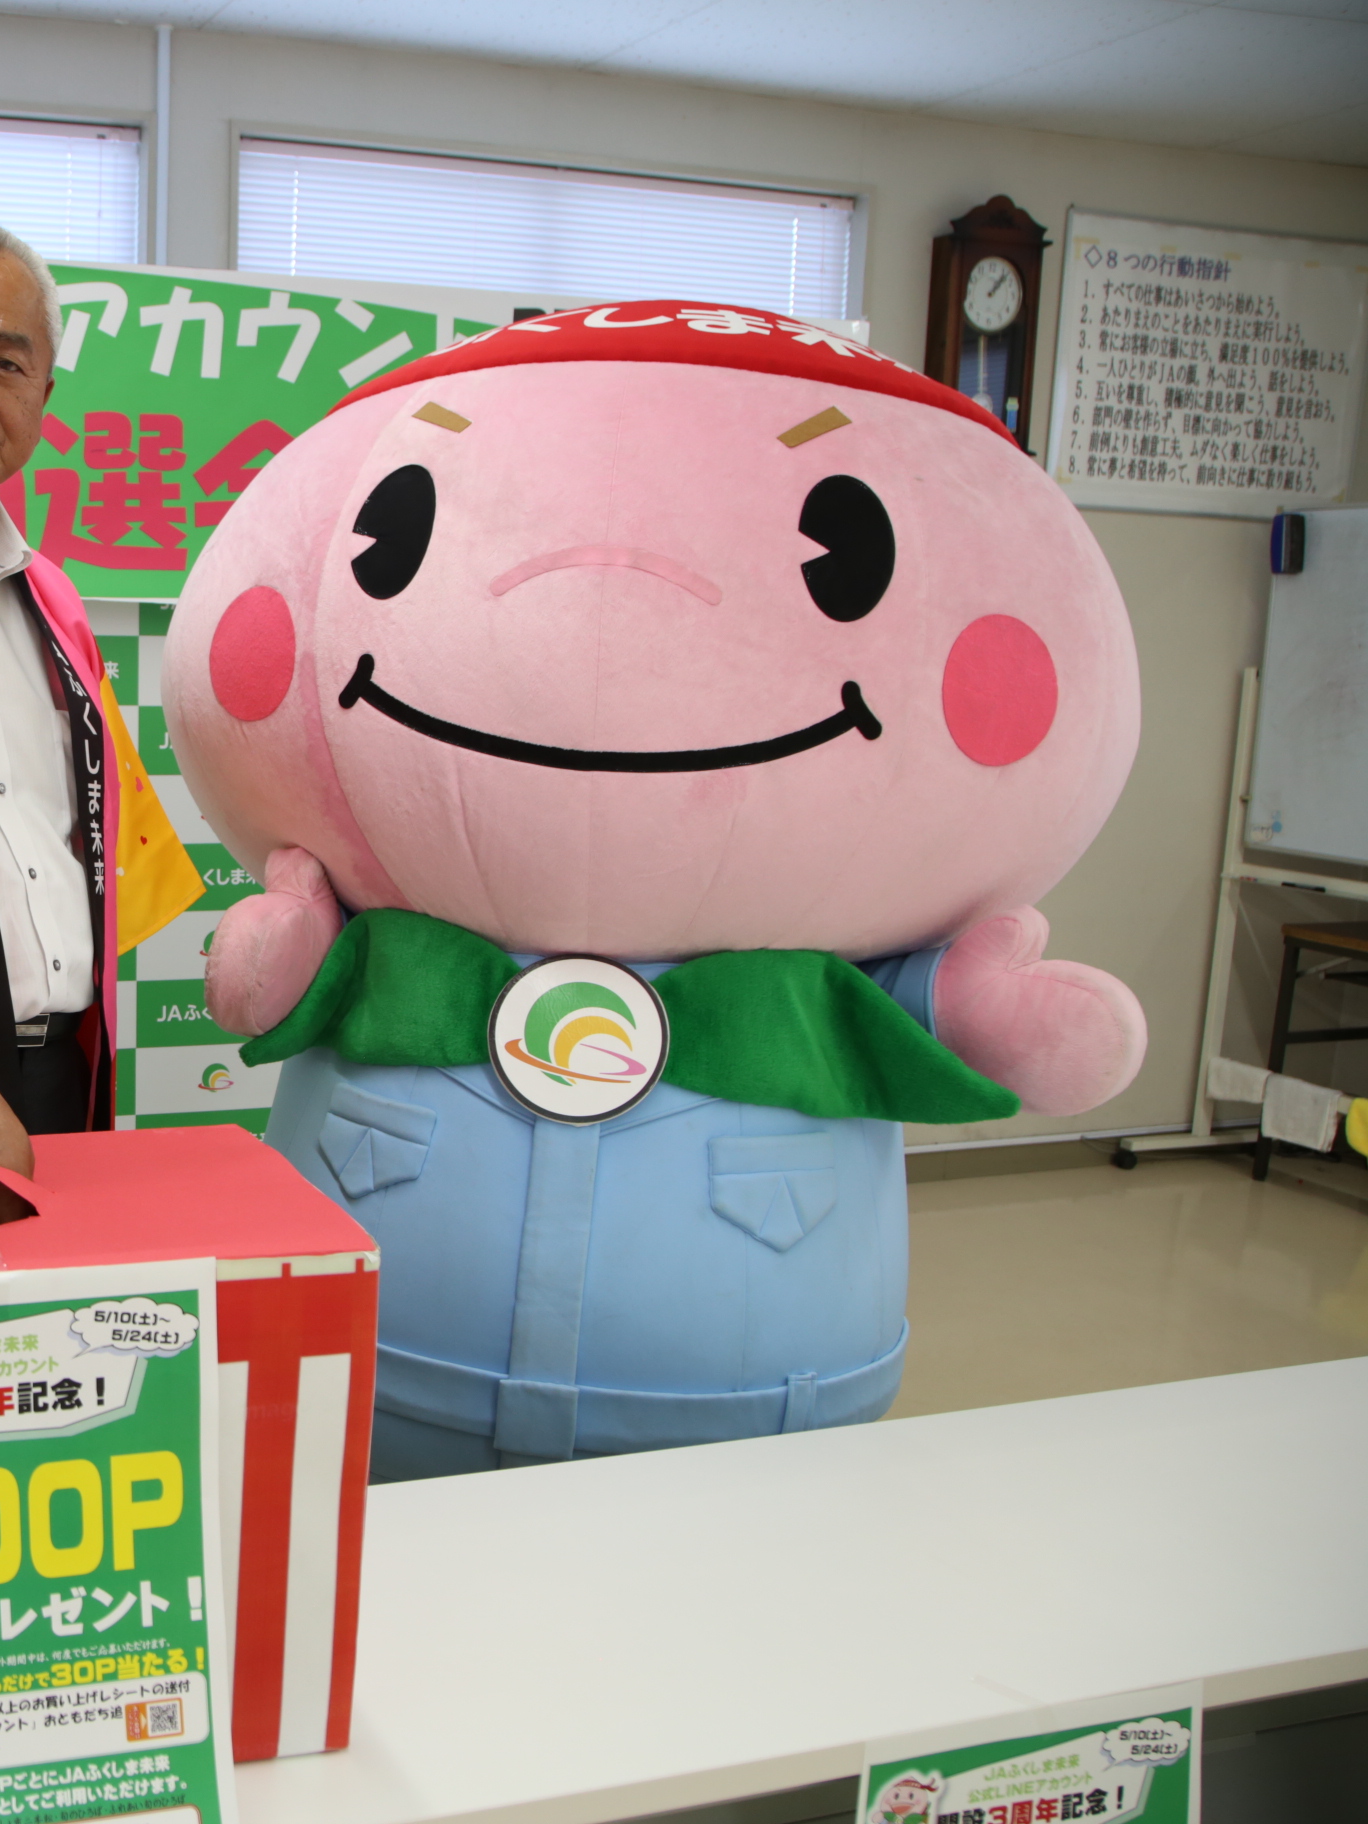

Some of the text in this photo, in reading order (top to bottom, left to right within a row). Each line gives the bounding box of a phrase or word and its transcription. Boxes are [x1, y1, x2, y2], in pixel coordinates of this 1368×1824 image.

[984, 1754, 1080, 1781] JAふくしま未来
[968, 1771, 1093, 1803] 公式LINEアカウント
